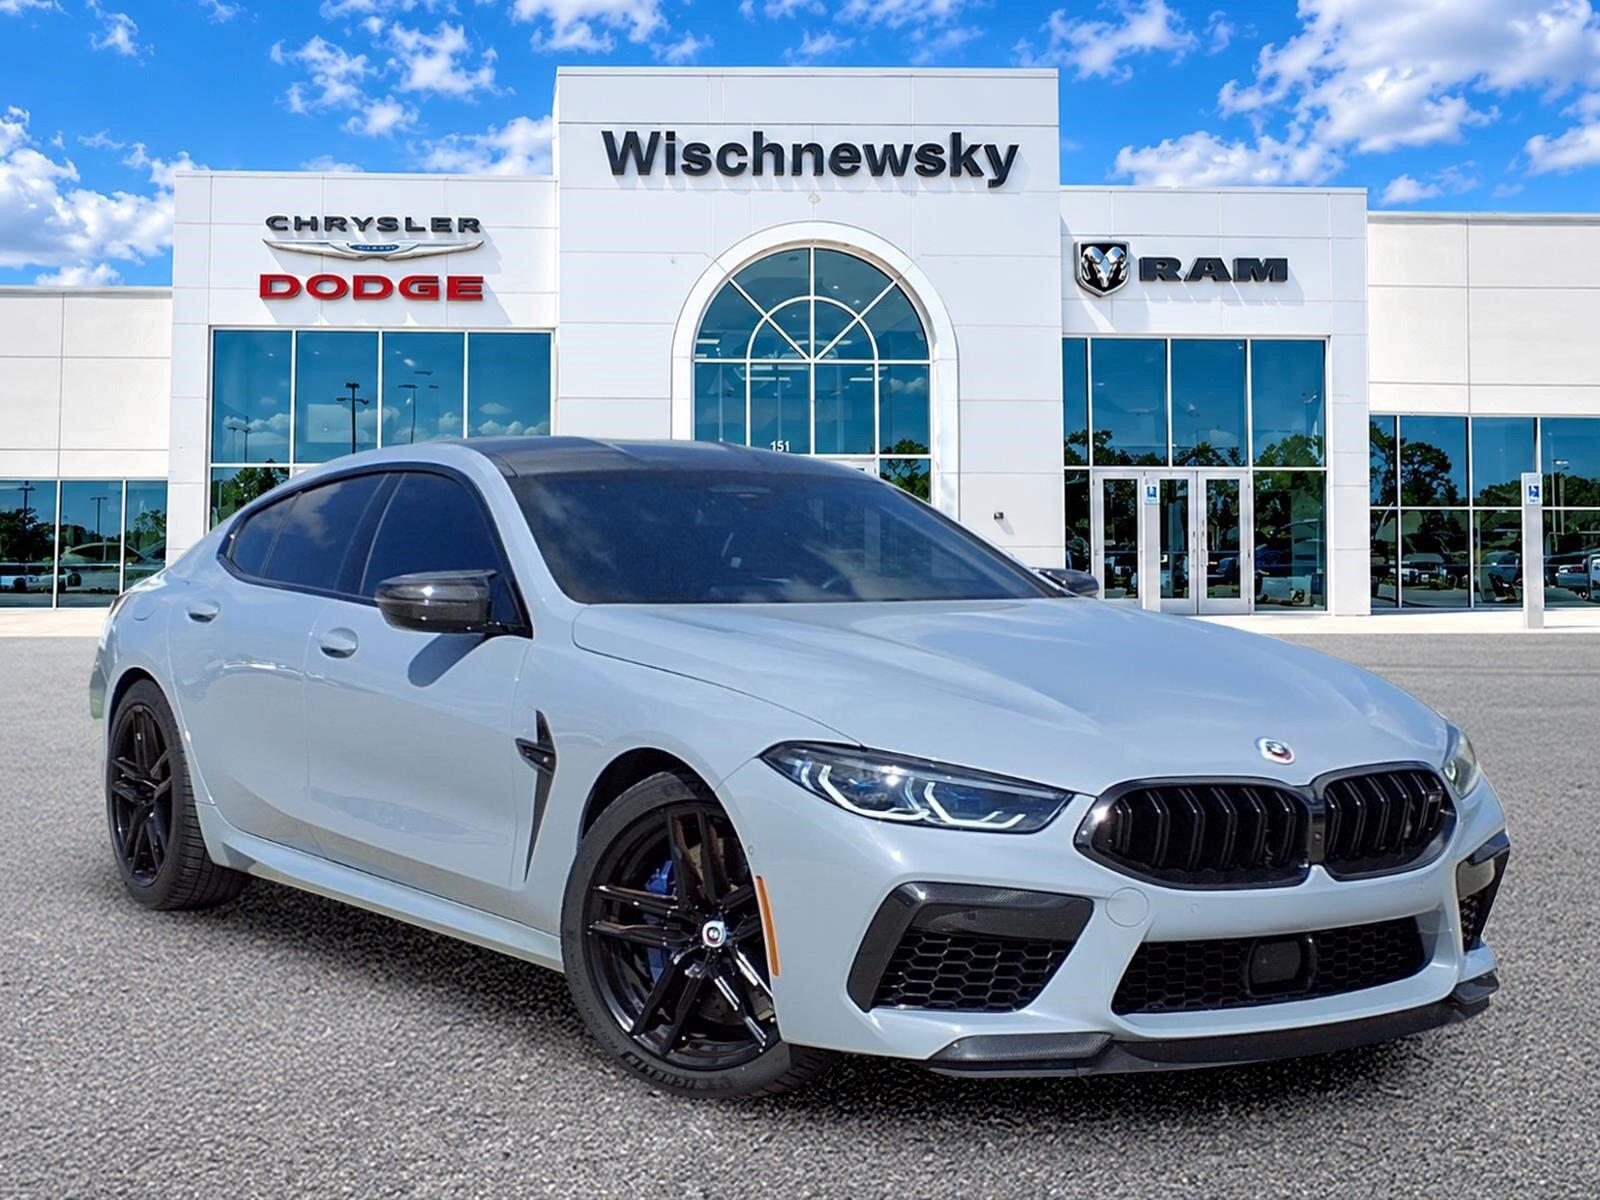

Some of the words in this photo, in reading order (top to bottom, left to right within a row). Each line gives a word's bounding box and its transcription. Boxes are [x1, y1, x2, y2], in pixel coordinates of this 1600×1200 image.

[602, 130, 1020, 187] Wischnewsky
[265, 215, 481, 233] CHRYSLER
[1138, 257, 1288, 282] RAM
[260, 274, 484, 301] DODGE
[770, 440, 790, 452] 151
